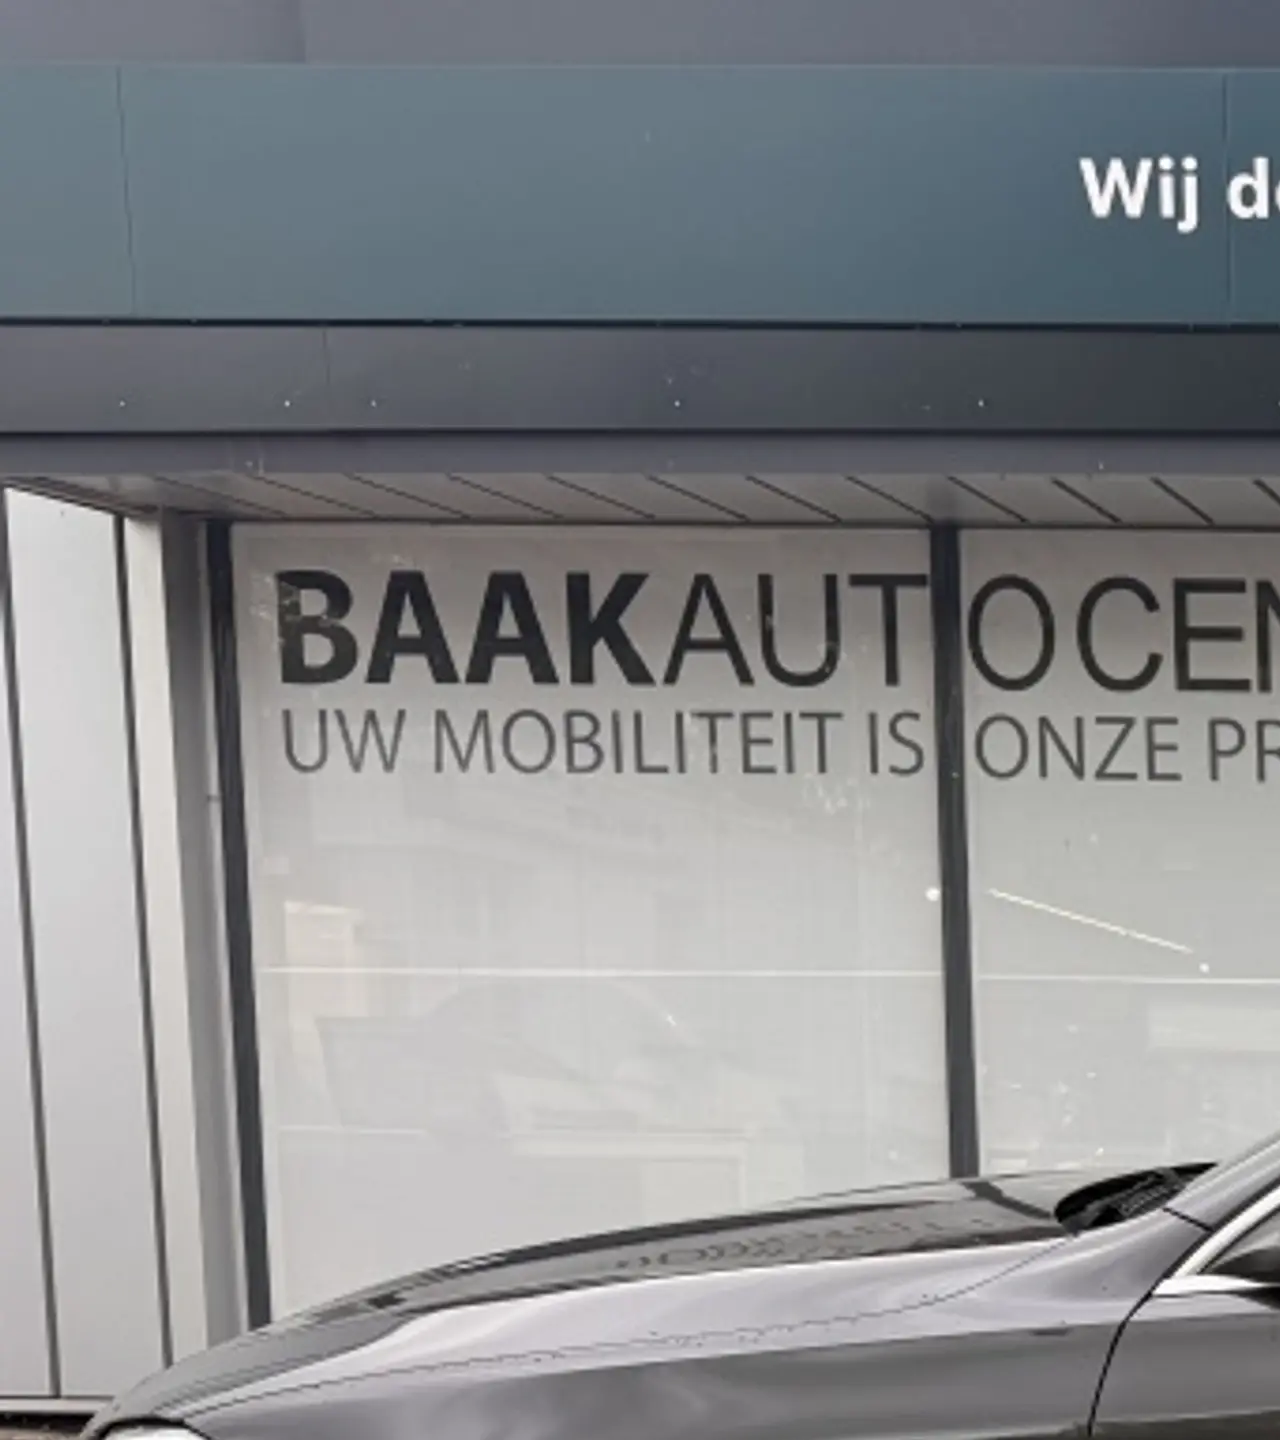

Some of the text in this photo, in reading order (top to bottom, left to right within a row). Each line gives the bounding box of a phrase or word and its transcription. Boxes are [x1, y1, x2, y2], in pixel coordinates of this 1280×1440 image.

[1079, 155, 1199, 234] Wij
[281, 708, 407, 774] UW
[433, 708, 844, 775] MOBILITEIT
[868, 711, 926, 776] IS
[974, 712, 1182, 781] ONZE
